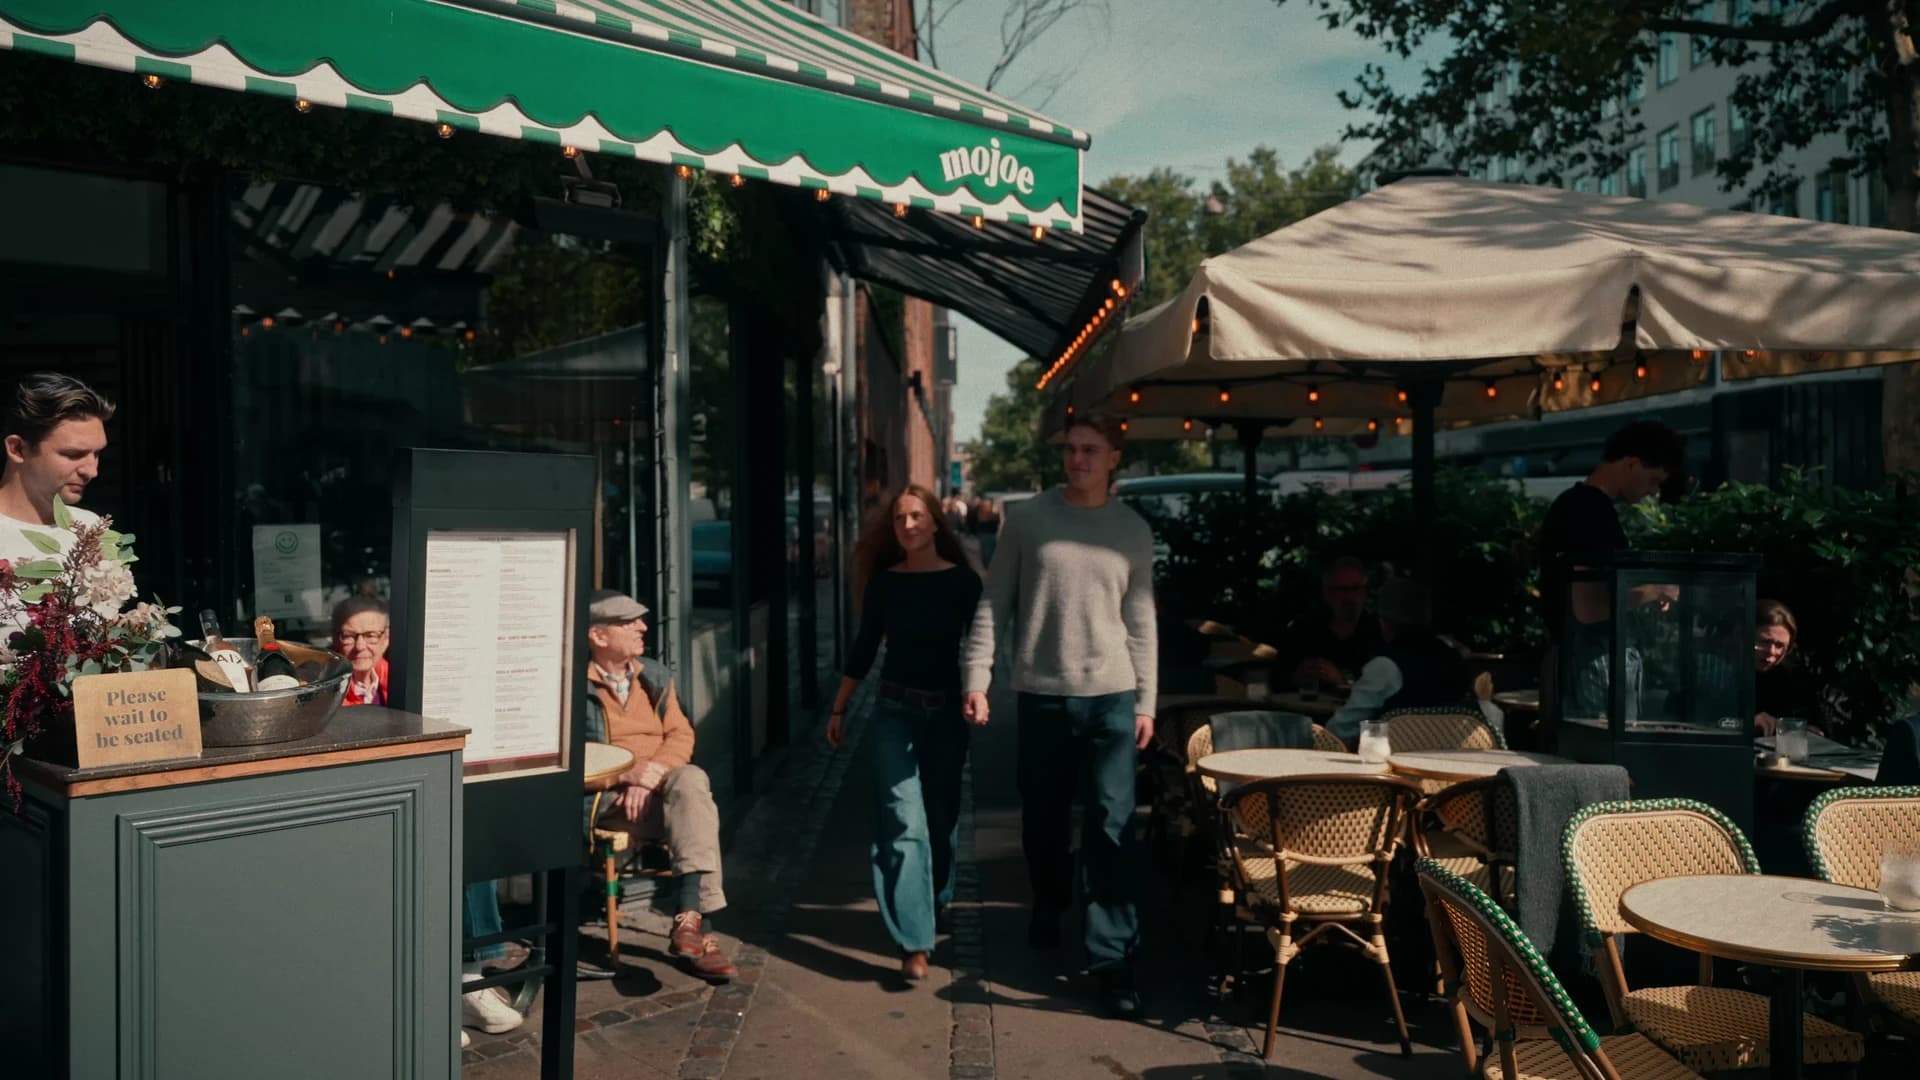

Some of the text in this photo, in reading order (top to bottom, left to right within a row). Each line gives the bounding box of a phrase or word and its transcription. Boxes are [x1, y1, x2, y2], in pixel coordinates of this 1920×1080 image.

[939, 137, 1034, 194] mojoe
[106, 689, 167, 706] Please
[104, 708, 168, 727] wait to
[96, 723, 183, 748] be seated
